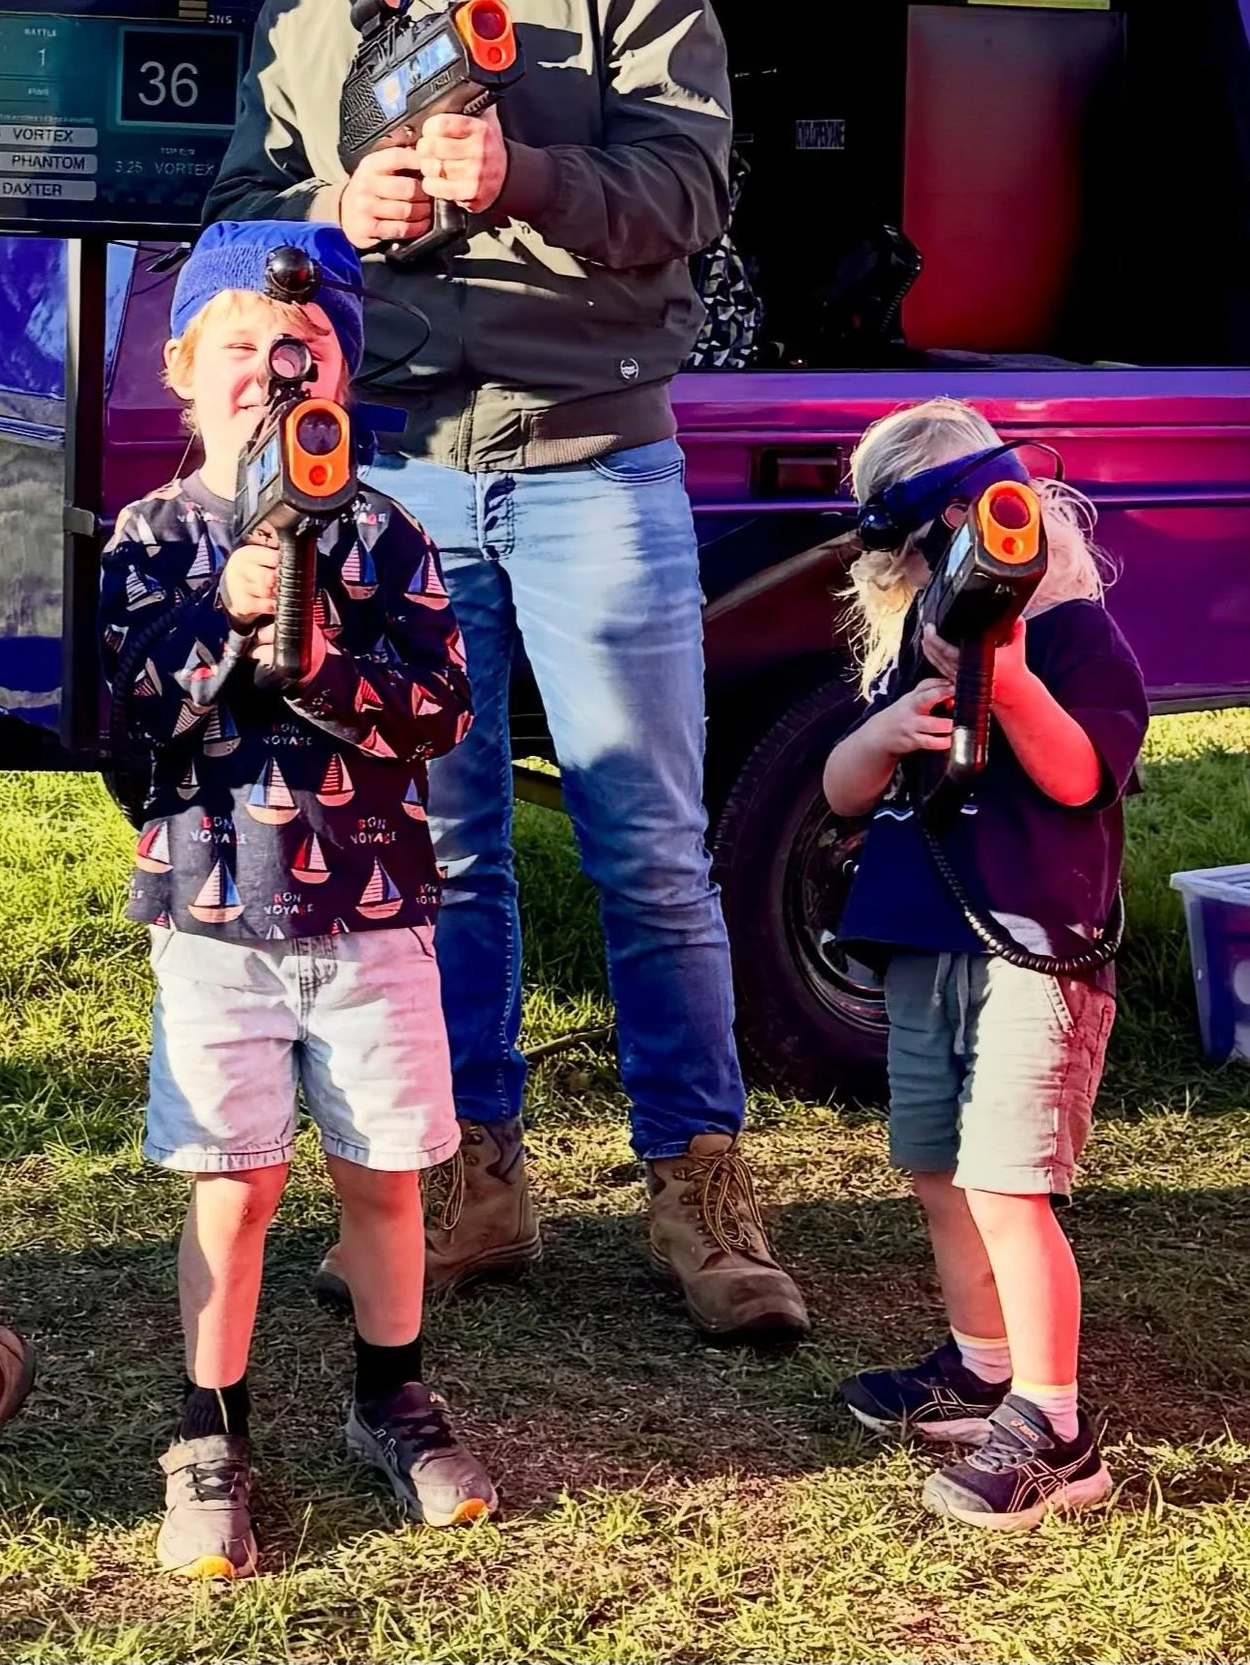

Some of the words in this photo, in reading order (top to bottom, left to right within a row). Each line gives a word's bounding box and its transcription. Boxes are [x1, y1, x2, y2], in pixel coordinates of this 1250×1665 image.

[24, 27, 57, 37] BATTLE
[37, 48, 46, 67] 1
[138, 61, 198, 107] 36
[12, 127, 74, 143] VORTEX
[12, 154, 86, 170] PHANTOM
[154, 162, 215, 176] VORTEX
[2, 182, 63, 196] DAXTER
[358, 816, 386, 830] BON
